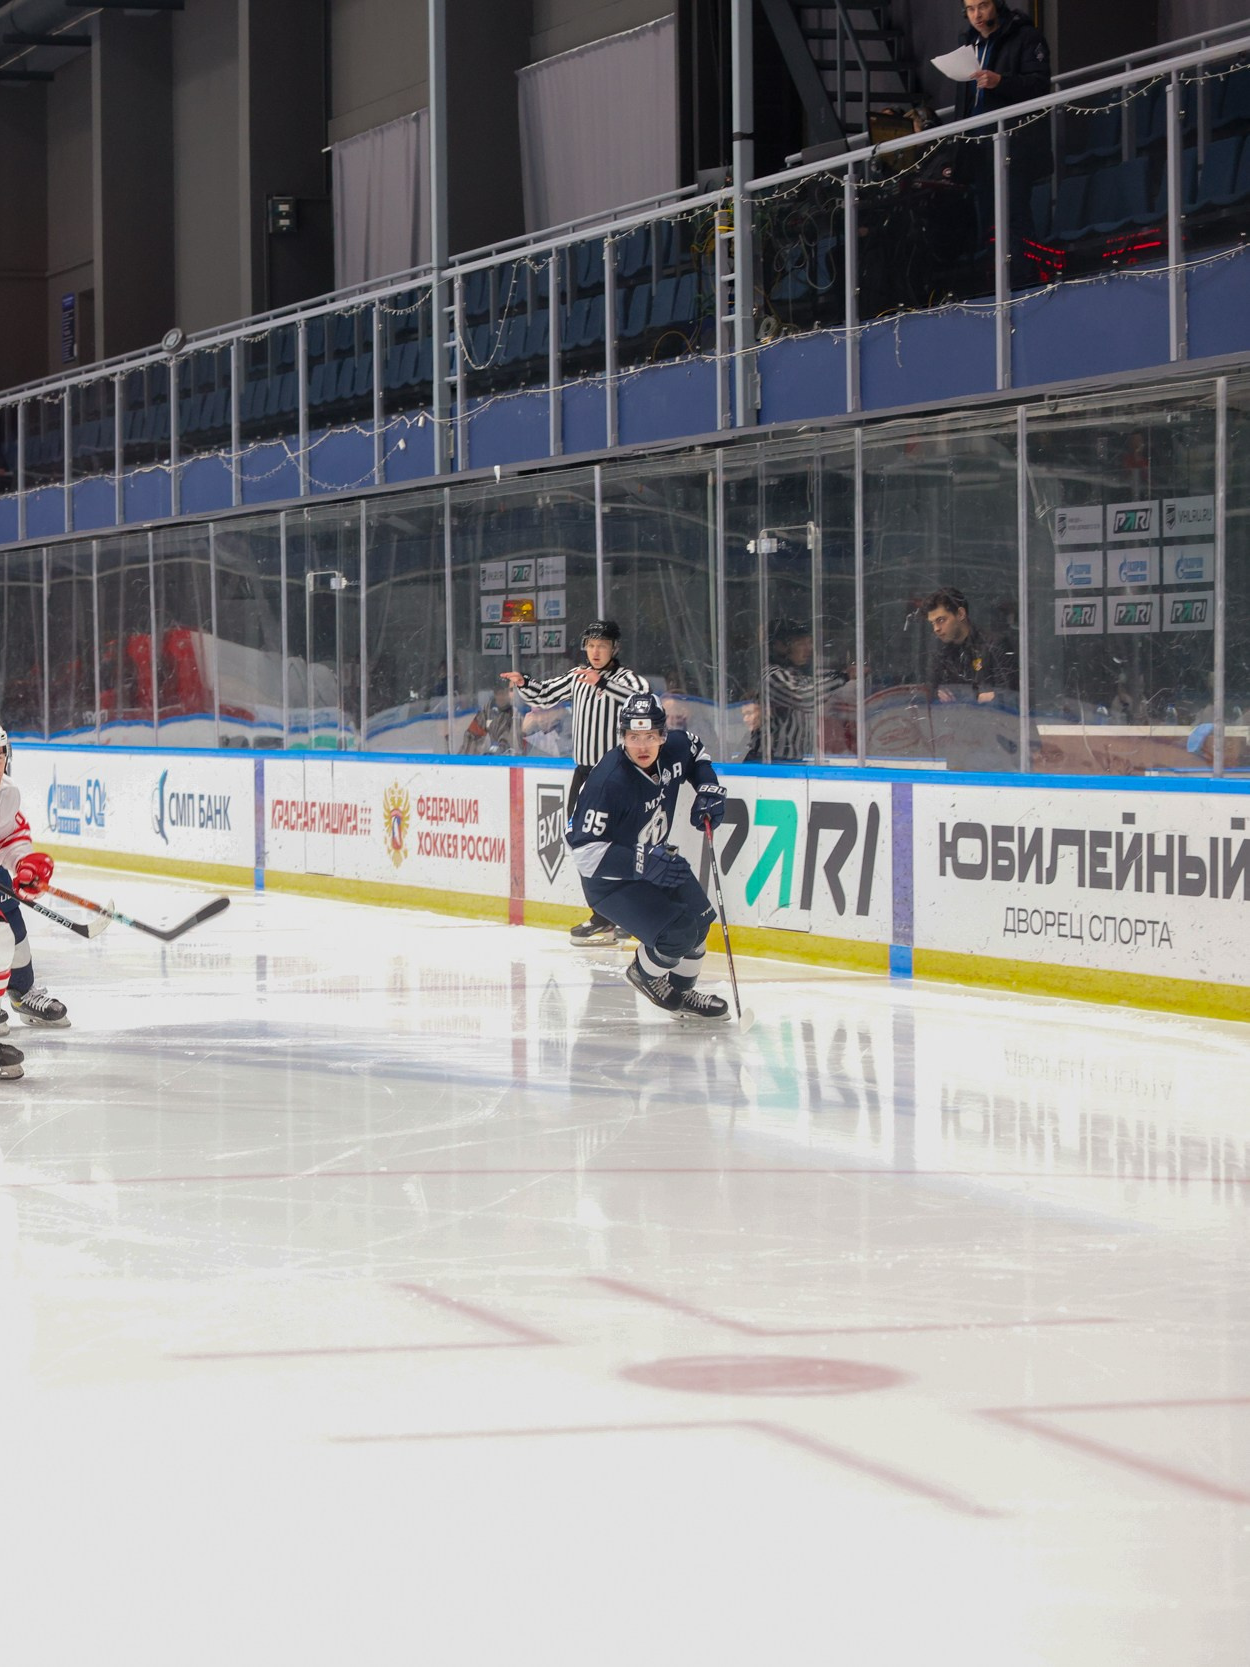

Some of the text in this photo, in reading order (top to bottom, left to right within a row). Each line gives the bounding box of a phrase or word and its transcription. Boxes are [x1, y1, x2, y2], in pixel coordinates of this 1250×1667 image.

[1115, 511, 1151, 533] PARI
[1063, 605, 1096, 627] PARI
[1115, 603, 1151, 626] PARI
[1172, 600, 1206, 623] PARI
[672, 762, 683, 779] A
[169, 792, 232, 831] СМП БАНК
[271, 799, 359, 836] КРАСНАЯ МАШИНА
[416, 795, 479, 828] ФЕДЕРАЦИЯ
[582, 808, 609, 836] 95
[416, 832, 506, 864] ХОККЕЯ РОССИИ
[699, 798, 881, 917] PARI
[938, 812, 1250, 902] ЮБИЛЕЙНЫЙ
[1003, 906, 1174, 949] ДВОРЕЦ СПОРТА
